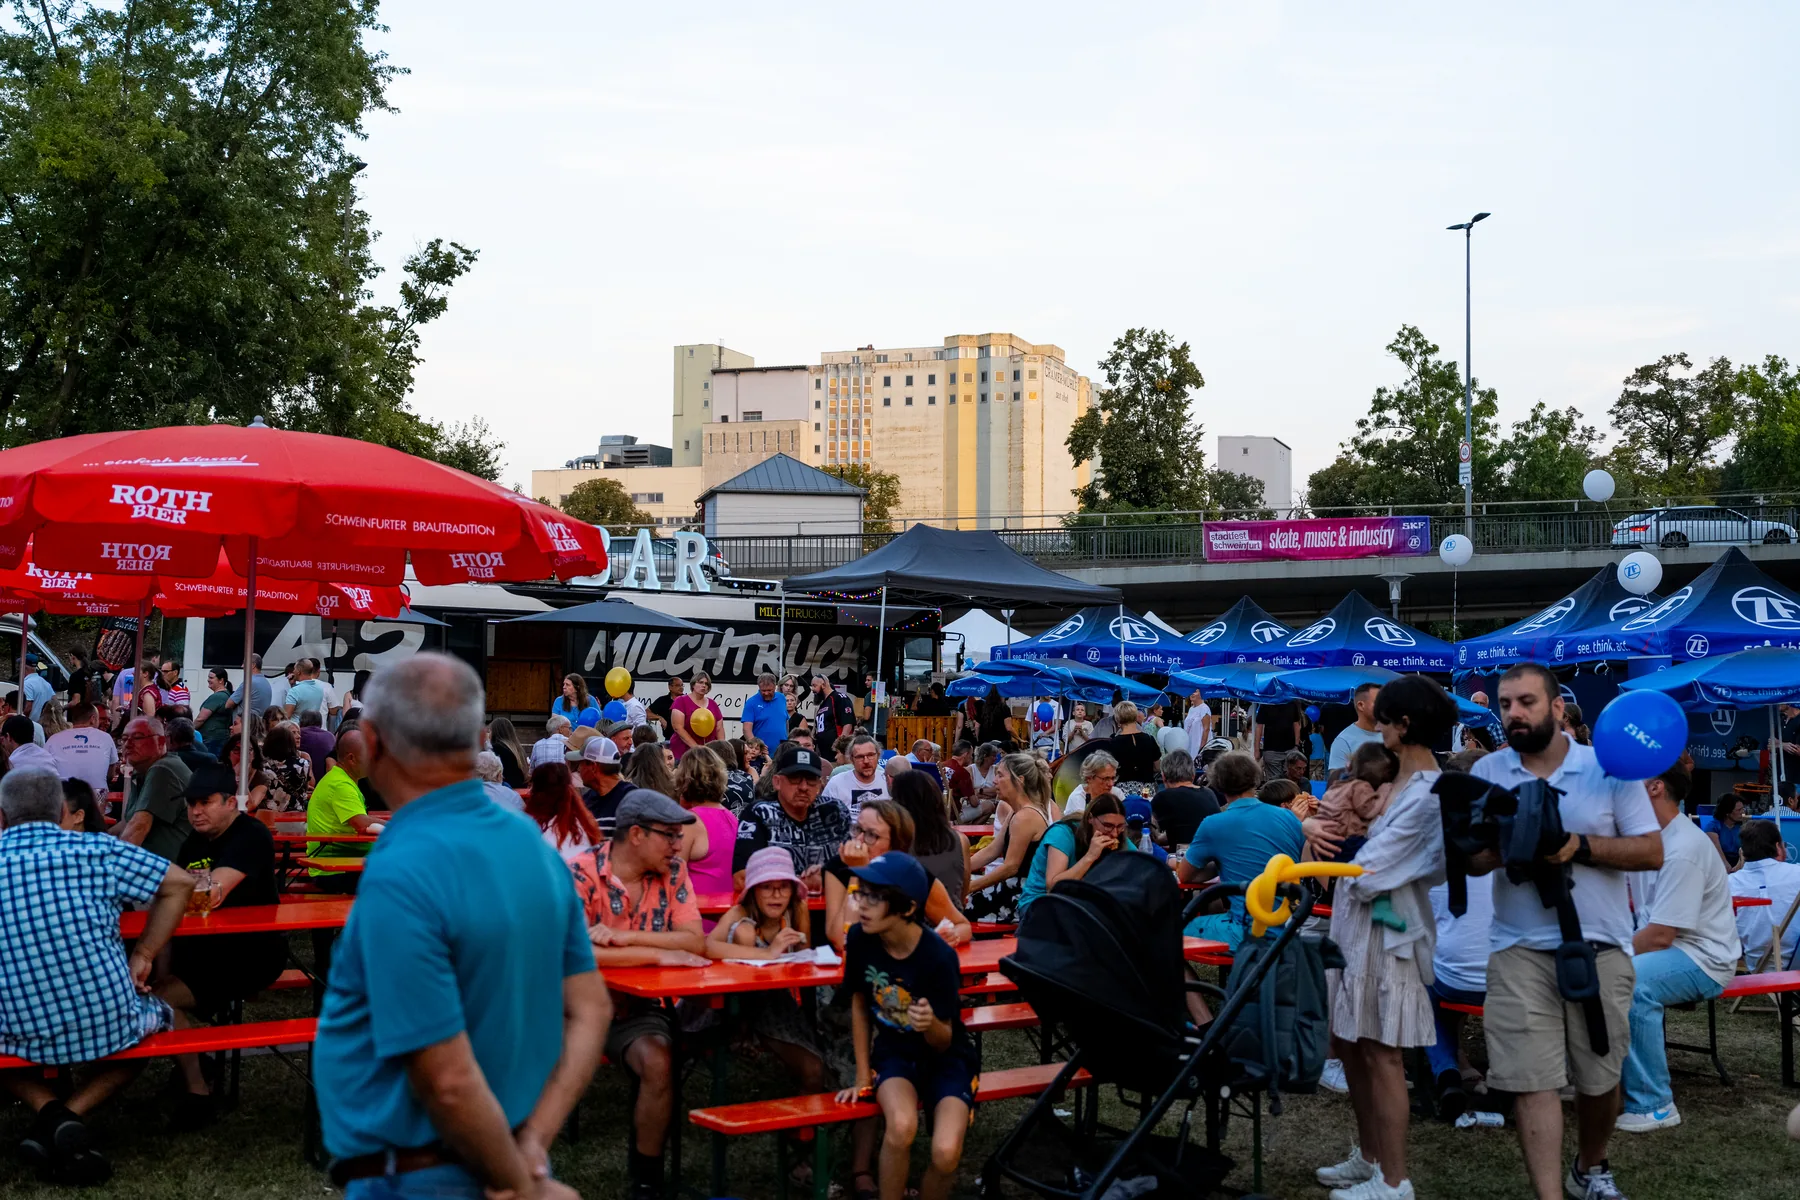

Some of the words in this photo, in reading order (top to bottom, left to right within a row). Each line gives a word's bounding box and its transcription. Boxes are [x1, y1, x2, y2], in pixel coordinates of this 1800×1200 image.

[104, 456, 174, 466] einfach
[179, 454, 248, 463] Klasse!
[109, 484, 213, 513] ROTH
[131, 504, 188, 524] BIER
[325, 513, 407, 531] SCHWEINFURTER
[413, 521, 495, 536] BRAUTRADITION
[1402, 521, 1426, 530] SKF
[1210, 531, 1248, 541] stadtfest
[1269, 528, 1301, 551] skate,
[1304, 529, 1336, 548] music
[1338, 528, 1347, 547] &
[1349, 526, 1395, 549] industry
[1408, 537, 1421, 547] ZF
[1213, 541, 1261, 550] schweinfurt
[1624, 563, 1641, 577] ZF
[41, 578, 77, 589] BIER
[175, 582, 234, 596] SCHWEINFURTER
[238, 588, 299, 601] BRUTRADITION
[1733, 593, 1800, 626] ZF
[1110, 620, 1158, 642] ZF
[1289, 621, 1335, 645] ZF
[1366, 621, 1415, 644] ZF
[1477, 649, 1489, 660] see.
[1489, 646, 1508, 659] think.
[1508, 646, 1520, 657] act.
[1577, 644, 1592, 655] see.
[1592, 639, 1615, 653] think.
[1615, 640, 1631, 652] act.
[1686, 637, 1709, 654] ZF
[584, 627, 870, 682] MILCHTRUCK
[1087, 649, 1100, 661] ZF
[1139, 653, 1165, 663] think.
[1167, 656, 1184, 665] act.
[1272, 656, 1293, 665] think.
[1294, 657, 1307, 665] act.
[1352, 655, 1365, 666] ZF
[1383, 658, 1401, 667] see.
[1402, 656, 1428, 666] think.
[1429, 659, 1446, 667] act.
[1758, 688, 1785, 696] think.
[1623, 722, 1662, 750] SKF
